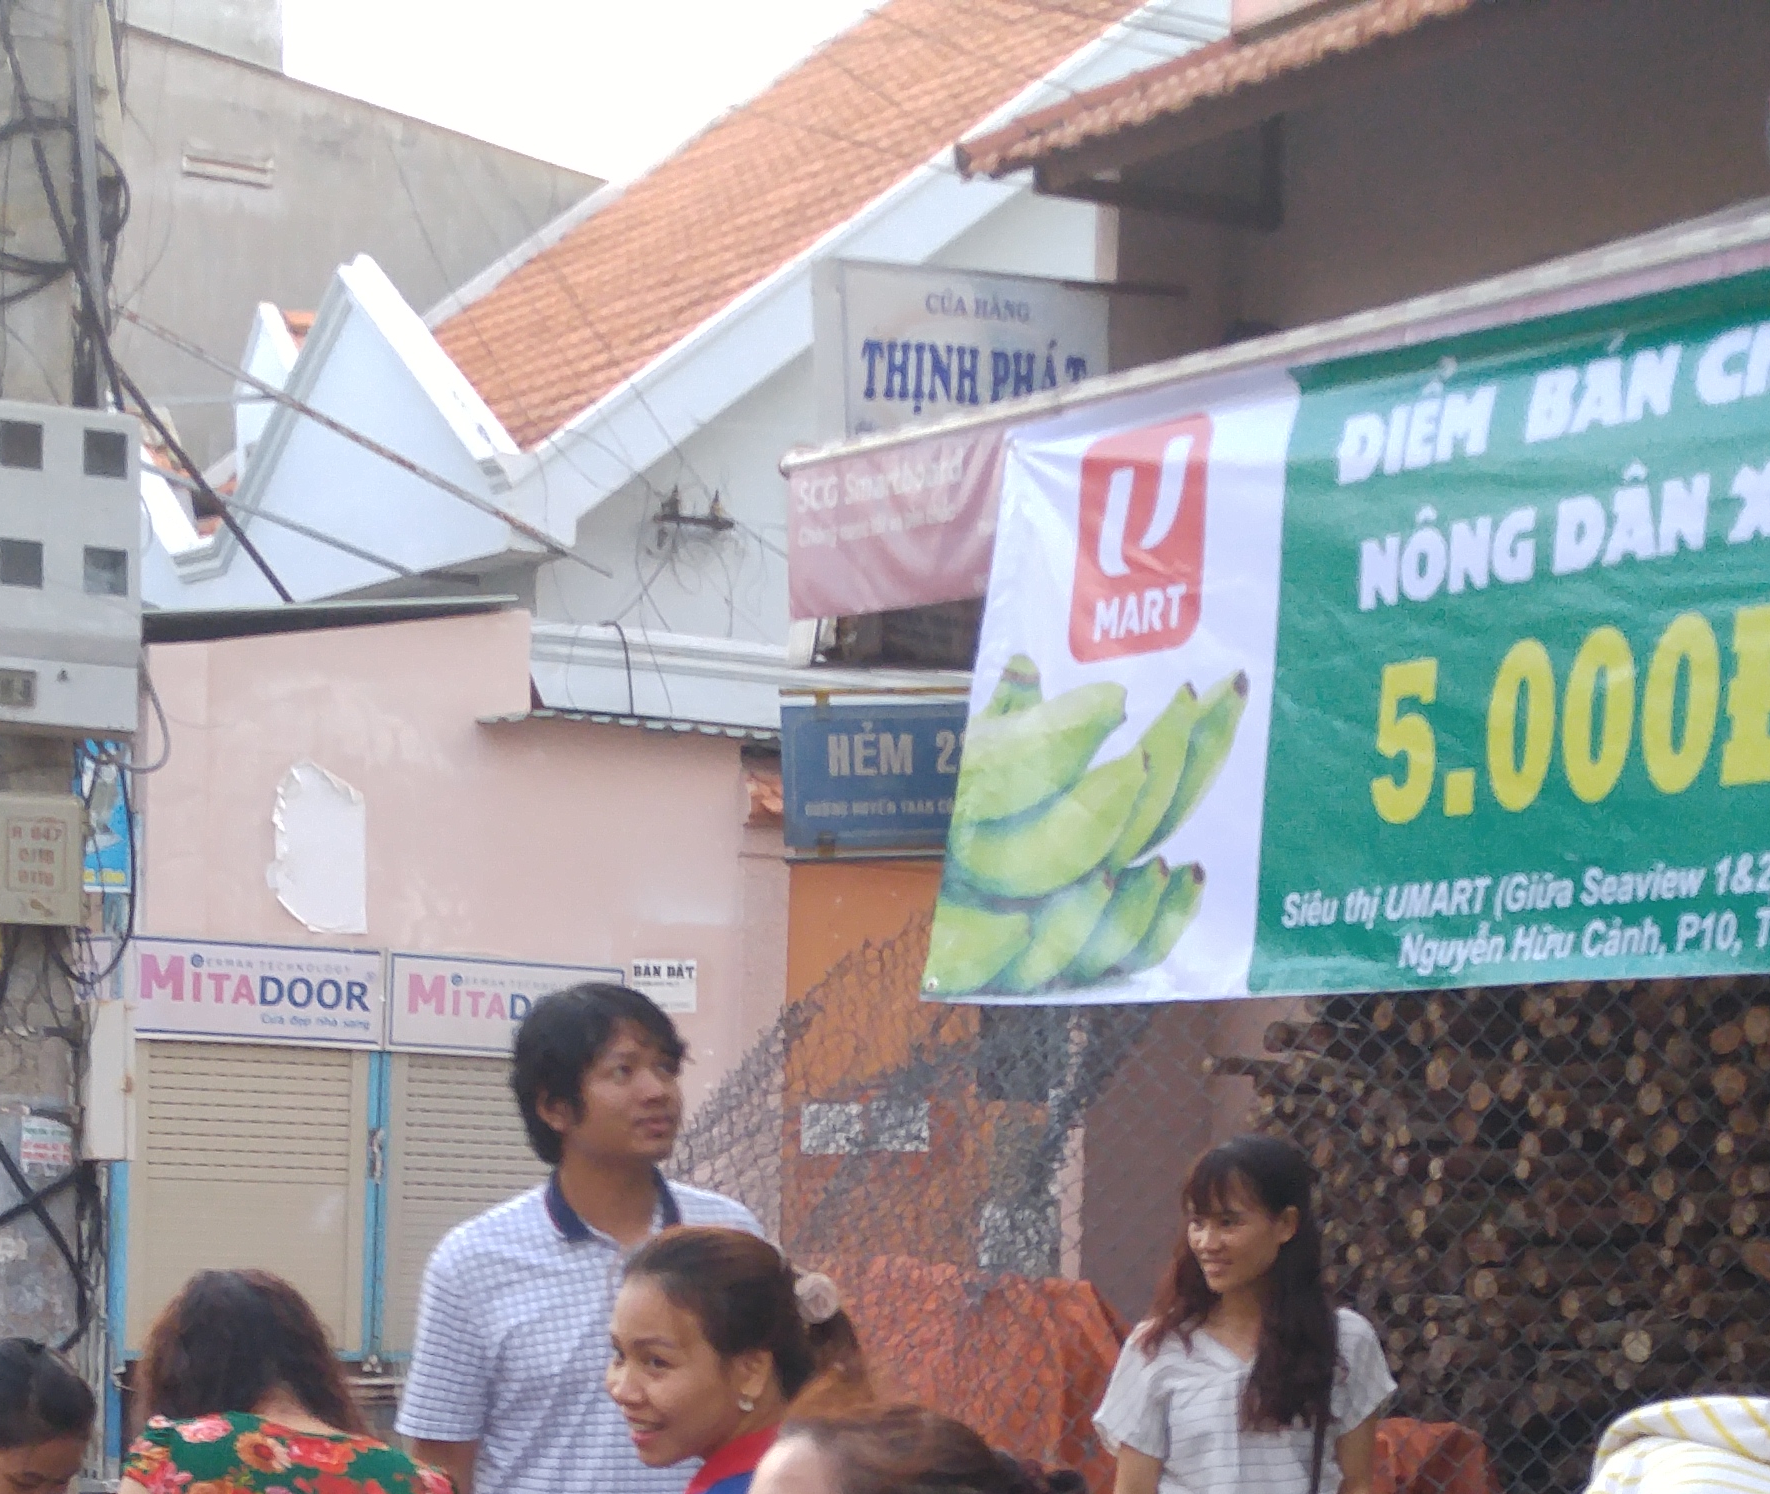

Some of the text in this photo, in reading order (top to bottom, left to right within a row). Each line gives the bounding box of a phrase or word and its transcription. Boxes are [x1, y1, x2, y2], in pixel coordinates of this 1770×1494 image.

[861, 337, 980, 415] THỊNH
[1357, 503, 1538, 612] NÔNG
[1550, 457, 1711, 577] DÂN
[1092, 583, 1188, 645] MART
[828, 720, 915, 778] HẺM
[1280, 888, 1340, 929] Siêu
[1342, 886, 1384, 930] thị
[1383, 874, 1494, 924] UMART
[1579, 862, 1709, 907] Seaview
[1508, 919, 1577, 963] Hữu
[1674, 909, 1742, 957] P10,
